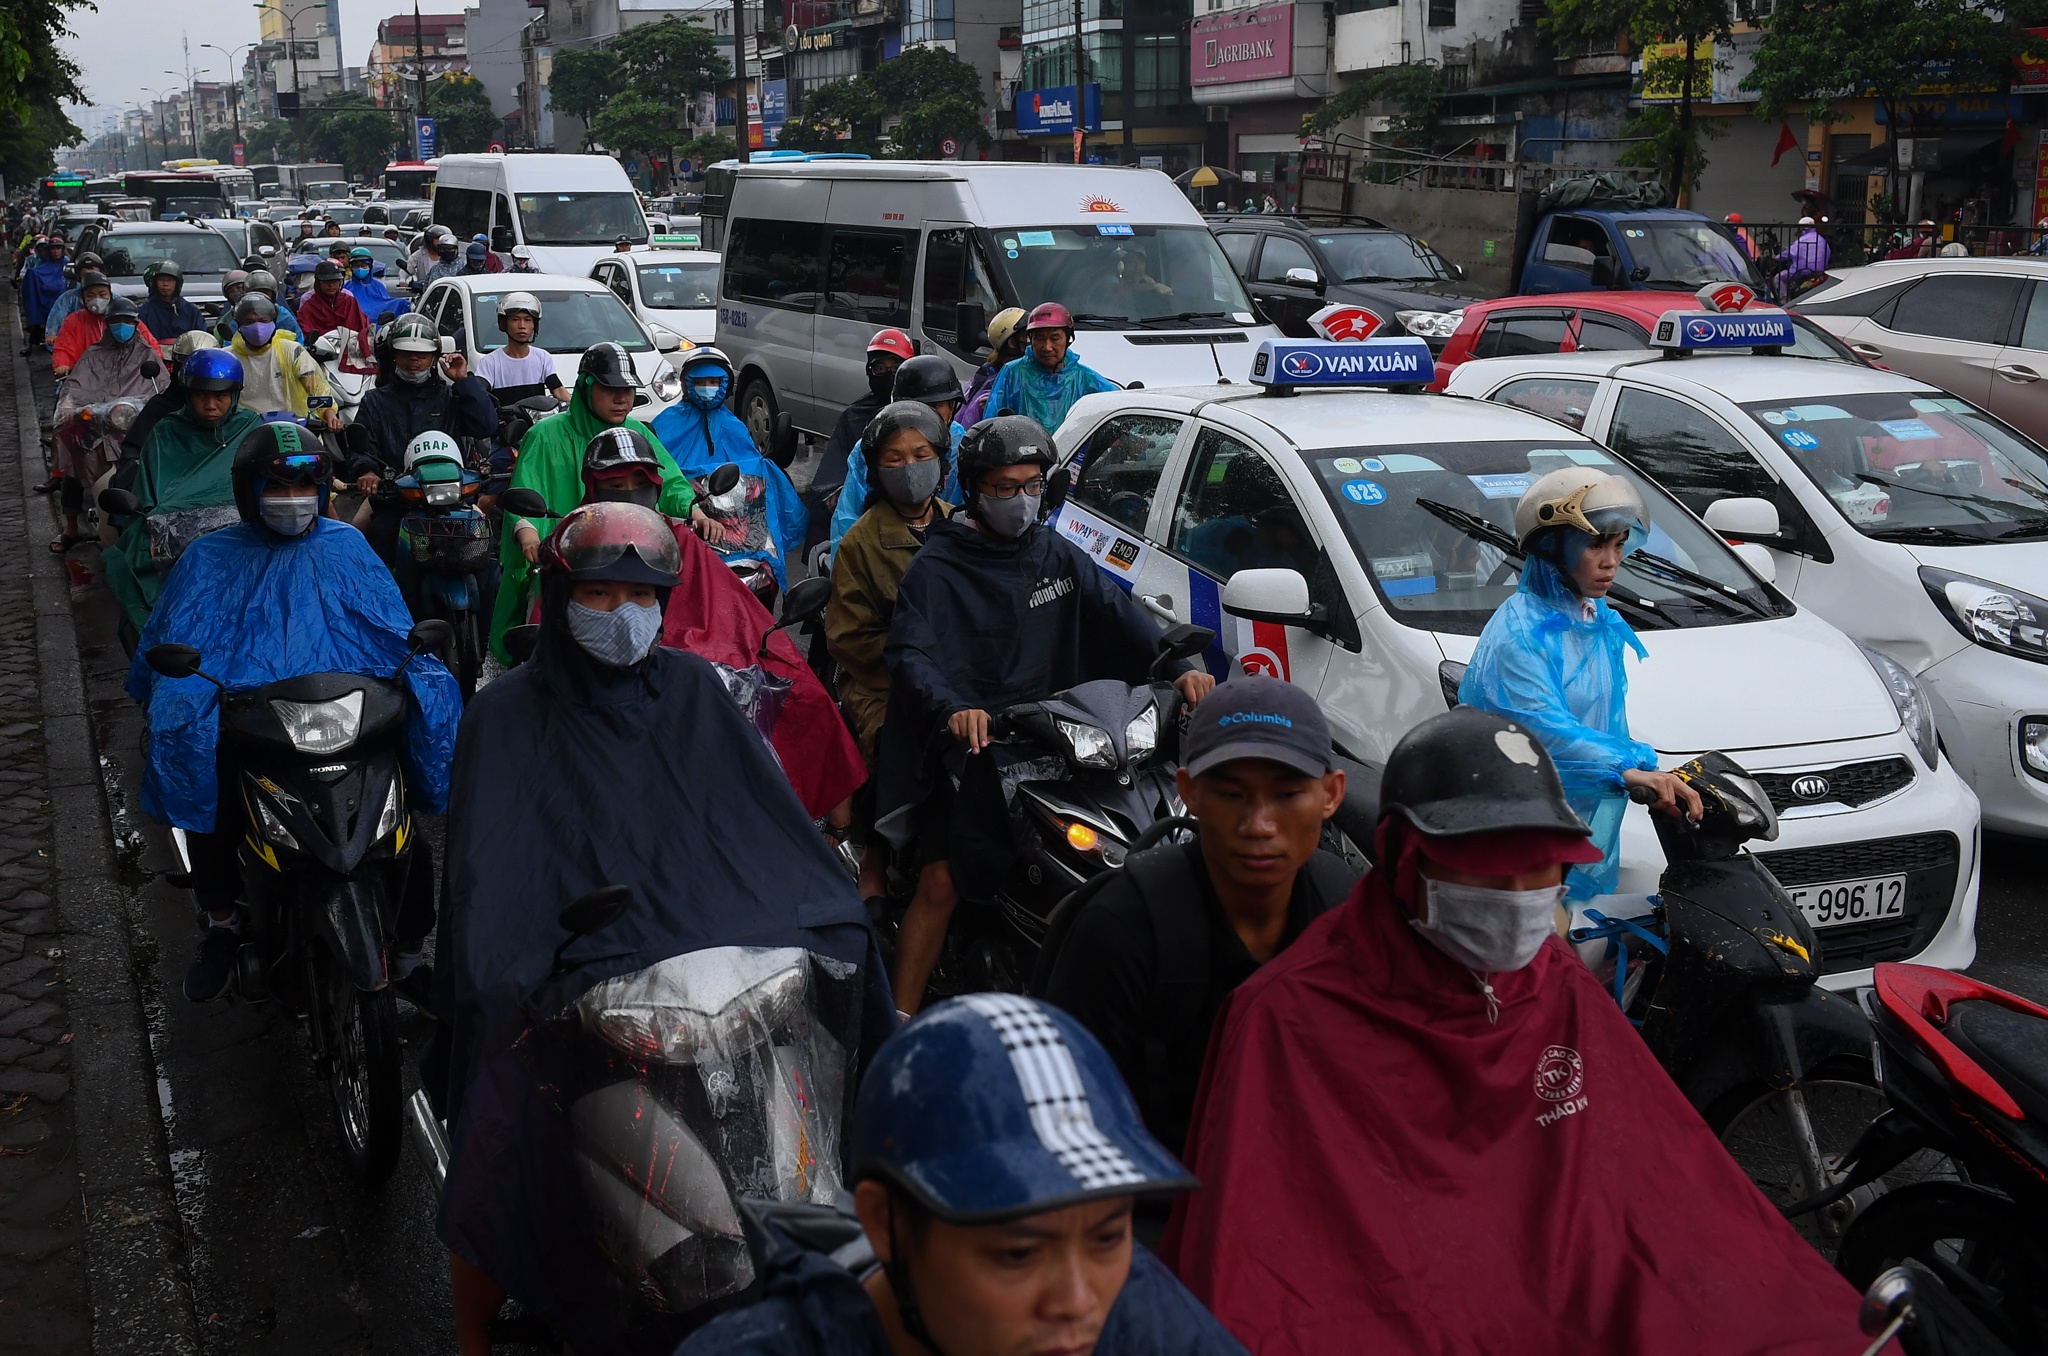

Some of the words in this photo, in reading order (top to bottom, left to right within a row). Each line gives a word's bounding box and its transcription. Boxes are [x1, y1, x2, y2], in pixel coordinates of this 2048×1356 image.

[1217, 39, 1274, 64] AGRIBANK
[1659, 331, 1670, 340] DI
[1661, 323, 1672, 332] EM
[1717, 323, 1746, 341] VẠN
[1748, 320, 1784, 337] XUÂN
[1324, 356, 1364, 377] VẠN
[1367, 351, 1418, 373] XUÂN
[413, 440, 449, 454] GRAP
[1784, 431, 1817, 447] 604
[1346, 483, 1383, 501] 625
[1068, 519, 1094, 539] VNPAY
[1231, 711, 1292, 728] Columbia
[309, 764, 348, 774] HONDA
[1797, 779, 1826, 796] KIA
[1548, 1049, 1566, 1059] CAO
[1544, 1065, 1568, 1084] TK
